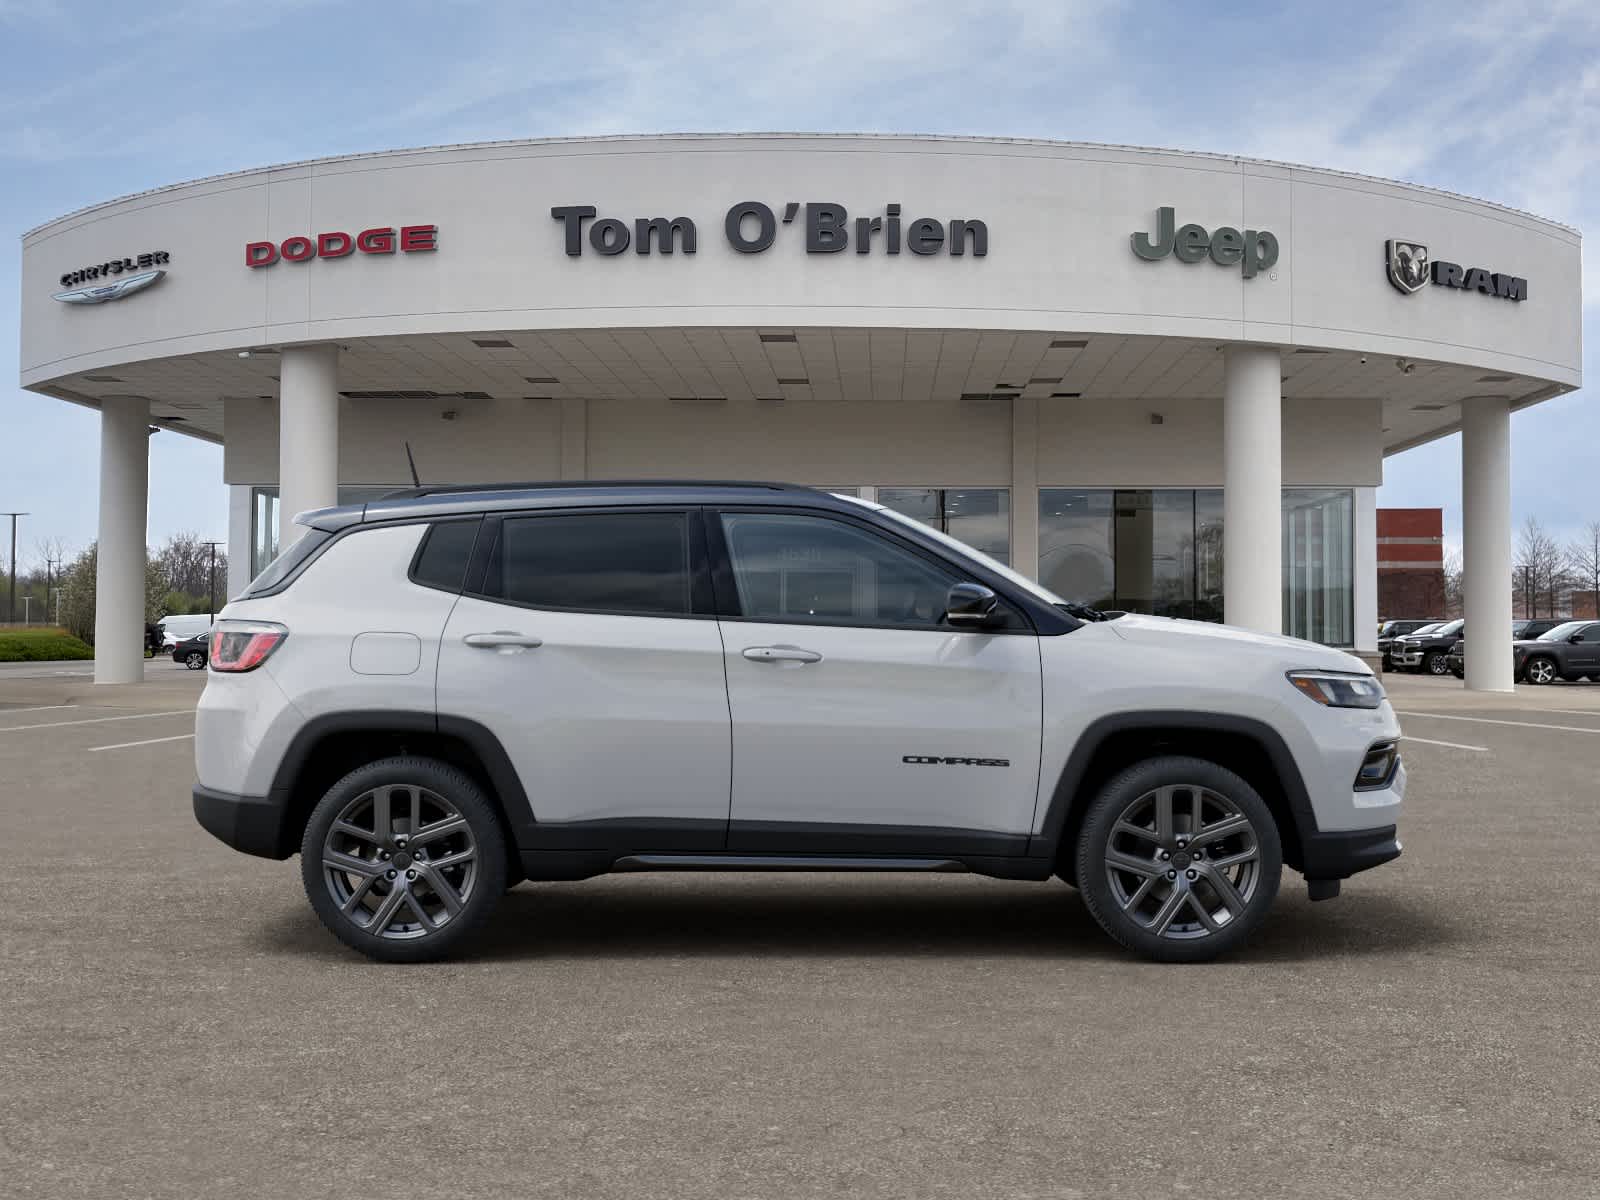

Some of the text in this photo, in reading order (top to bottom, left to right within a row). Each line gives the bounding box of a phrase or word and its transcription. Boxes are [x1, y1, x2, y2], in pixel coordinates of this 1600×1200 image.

[245, 224, 438, 269] DODGE
[551, 201, 988, 256] Tom O'Brien
[1130, 207, 1279, 279] Jeep
[60, 250, 170, 287] CHRYSLER
[1431, 260, 1528, 301] RAM
[902, 756, 1010, 767] COMPASS
